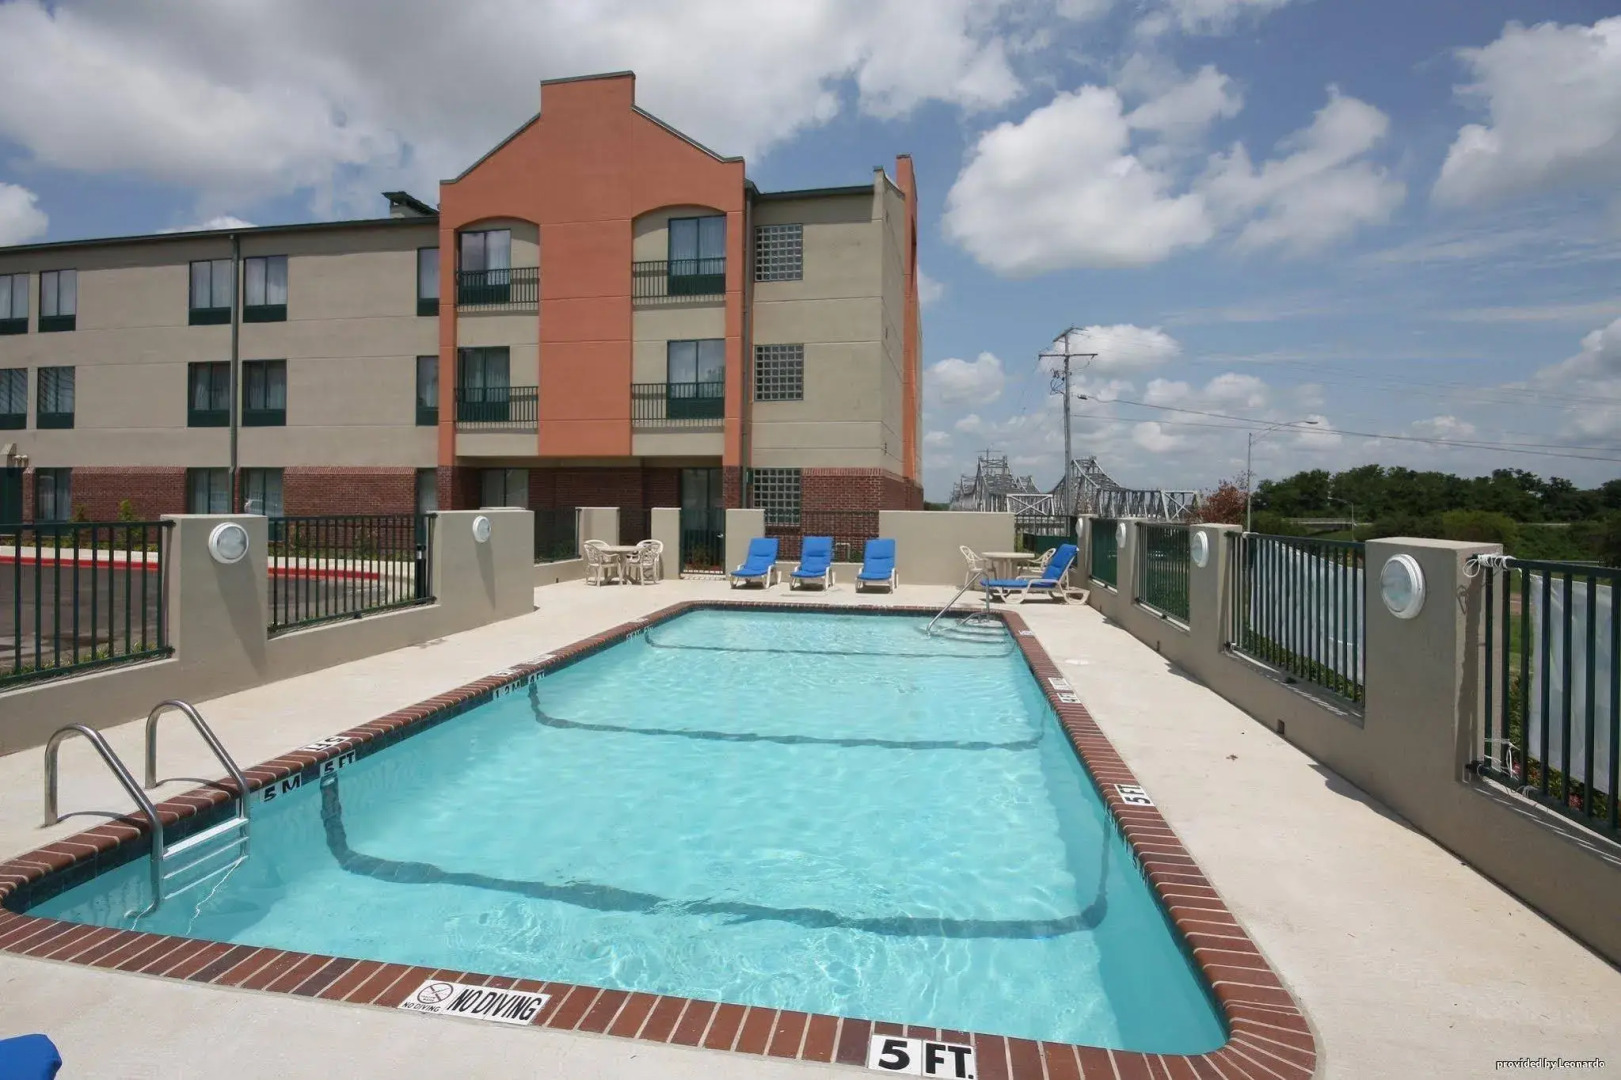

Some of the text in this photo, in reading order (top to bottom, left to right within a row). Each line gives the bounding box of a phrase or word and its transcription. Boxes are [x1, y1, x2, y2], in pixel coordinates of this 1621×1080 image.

[325, 751, 355, 774] 5 FT
[264, 775, 300, 802] 5 M
[1117, 784, 1150, 804] 5 FT
[402, 1001, 441, 1013] NO DIVING
[446, 988, 543, 1021] NO DIVING
[878, 1038, 974, 1080] 5 FT.
